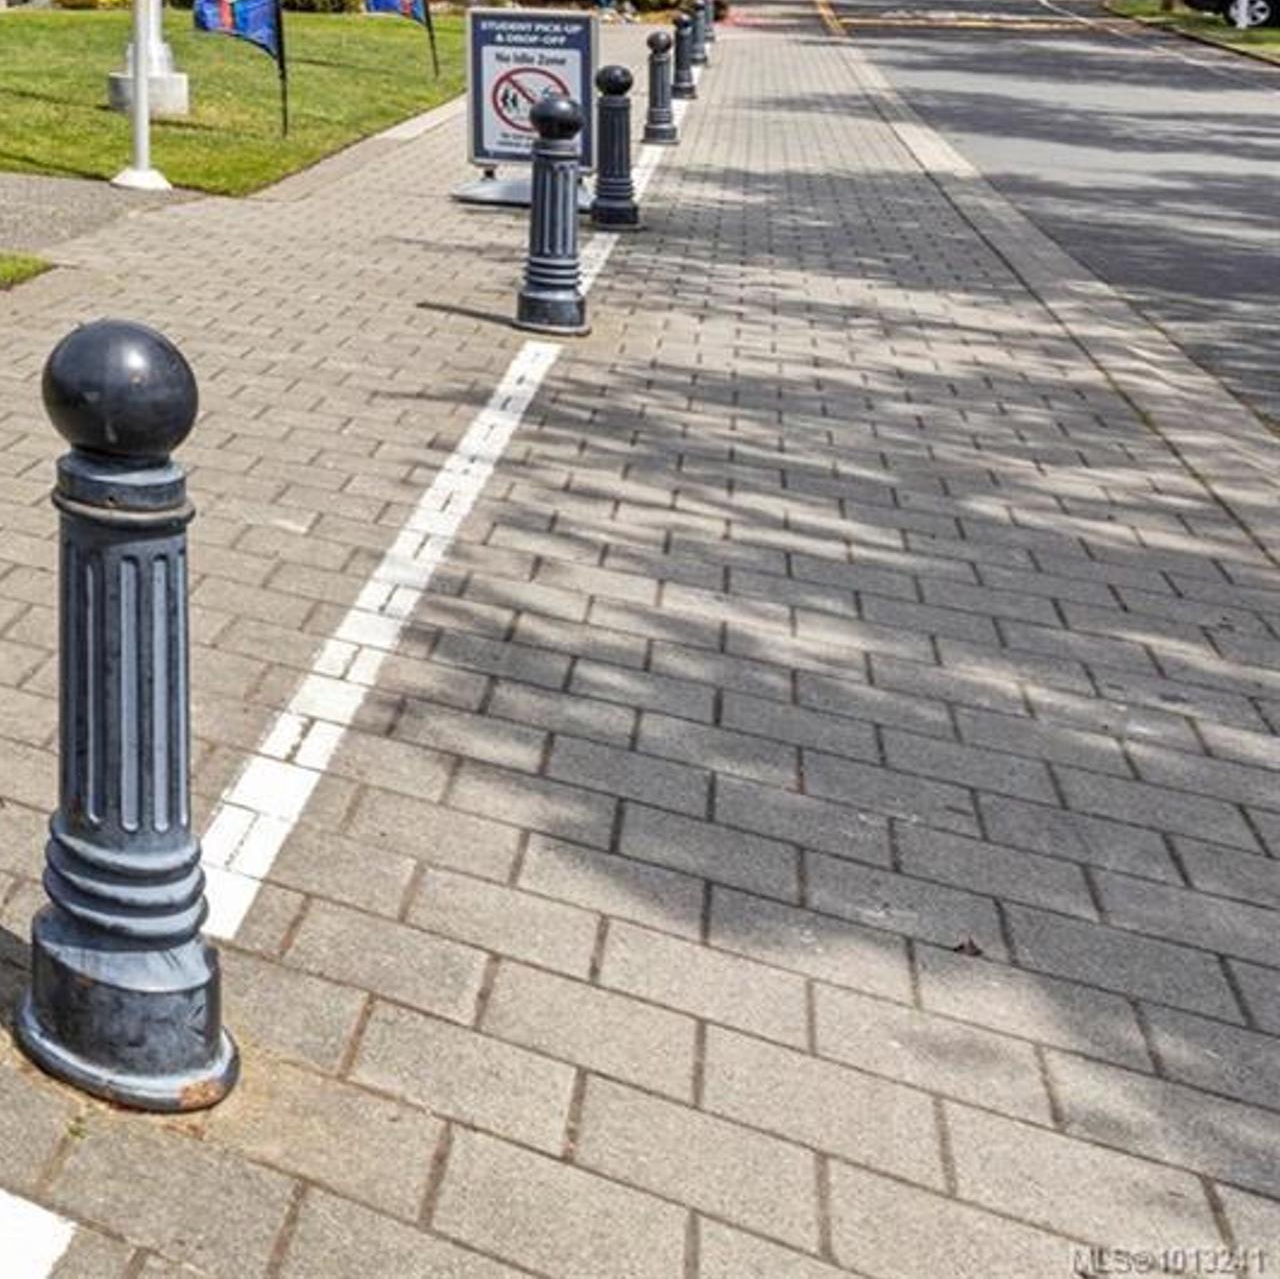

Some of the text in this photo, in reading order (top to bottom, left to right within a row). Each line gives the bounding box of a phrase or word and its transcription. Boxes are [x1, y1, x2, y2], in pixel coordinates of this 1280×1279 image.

[481, 21, 583, 35] STUDENT PICK-UP
[506, 34, 567, 46] DROP-OFF
[538, 54, 567, 66] Zone
